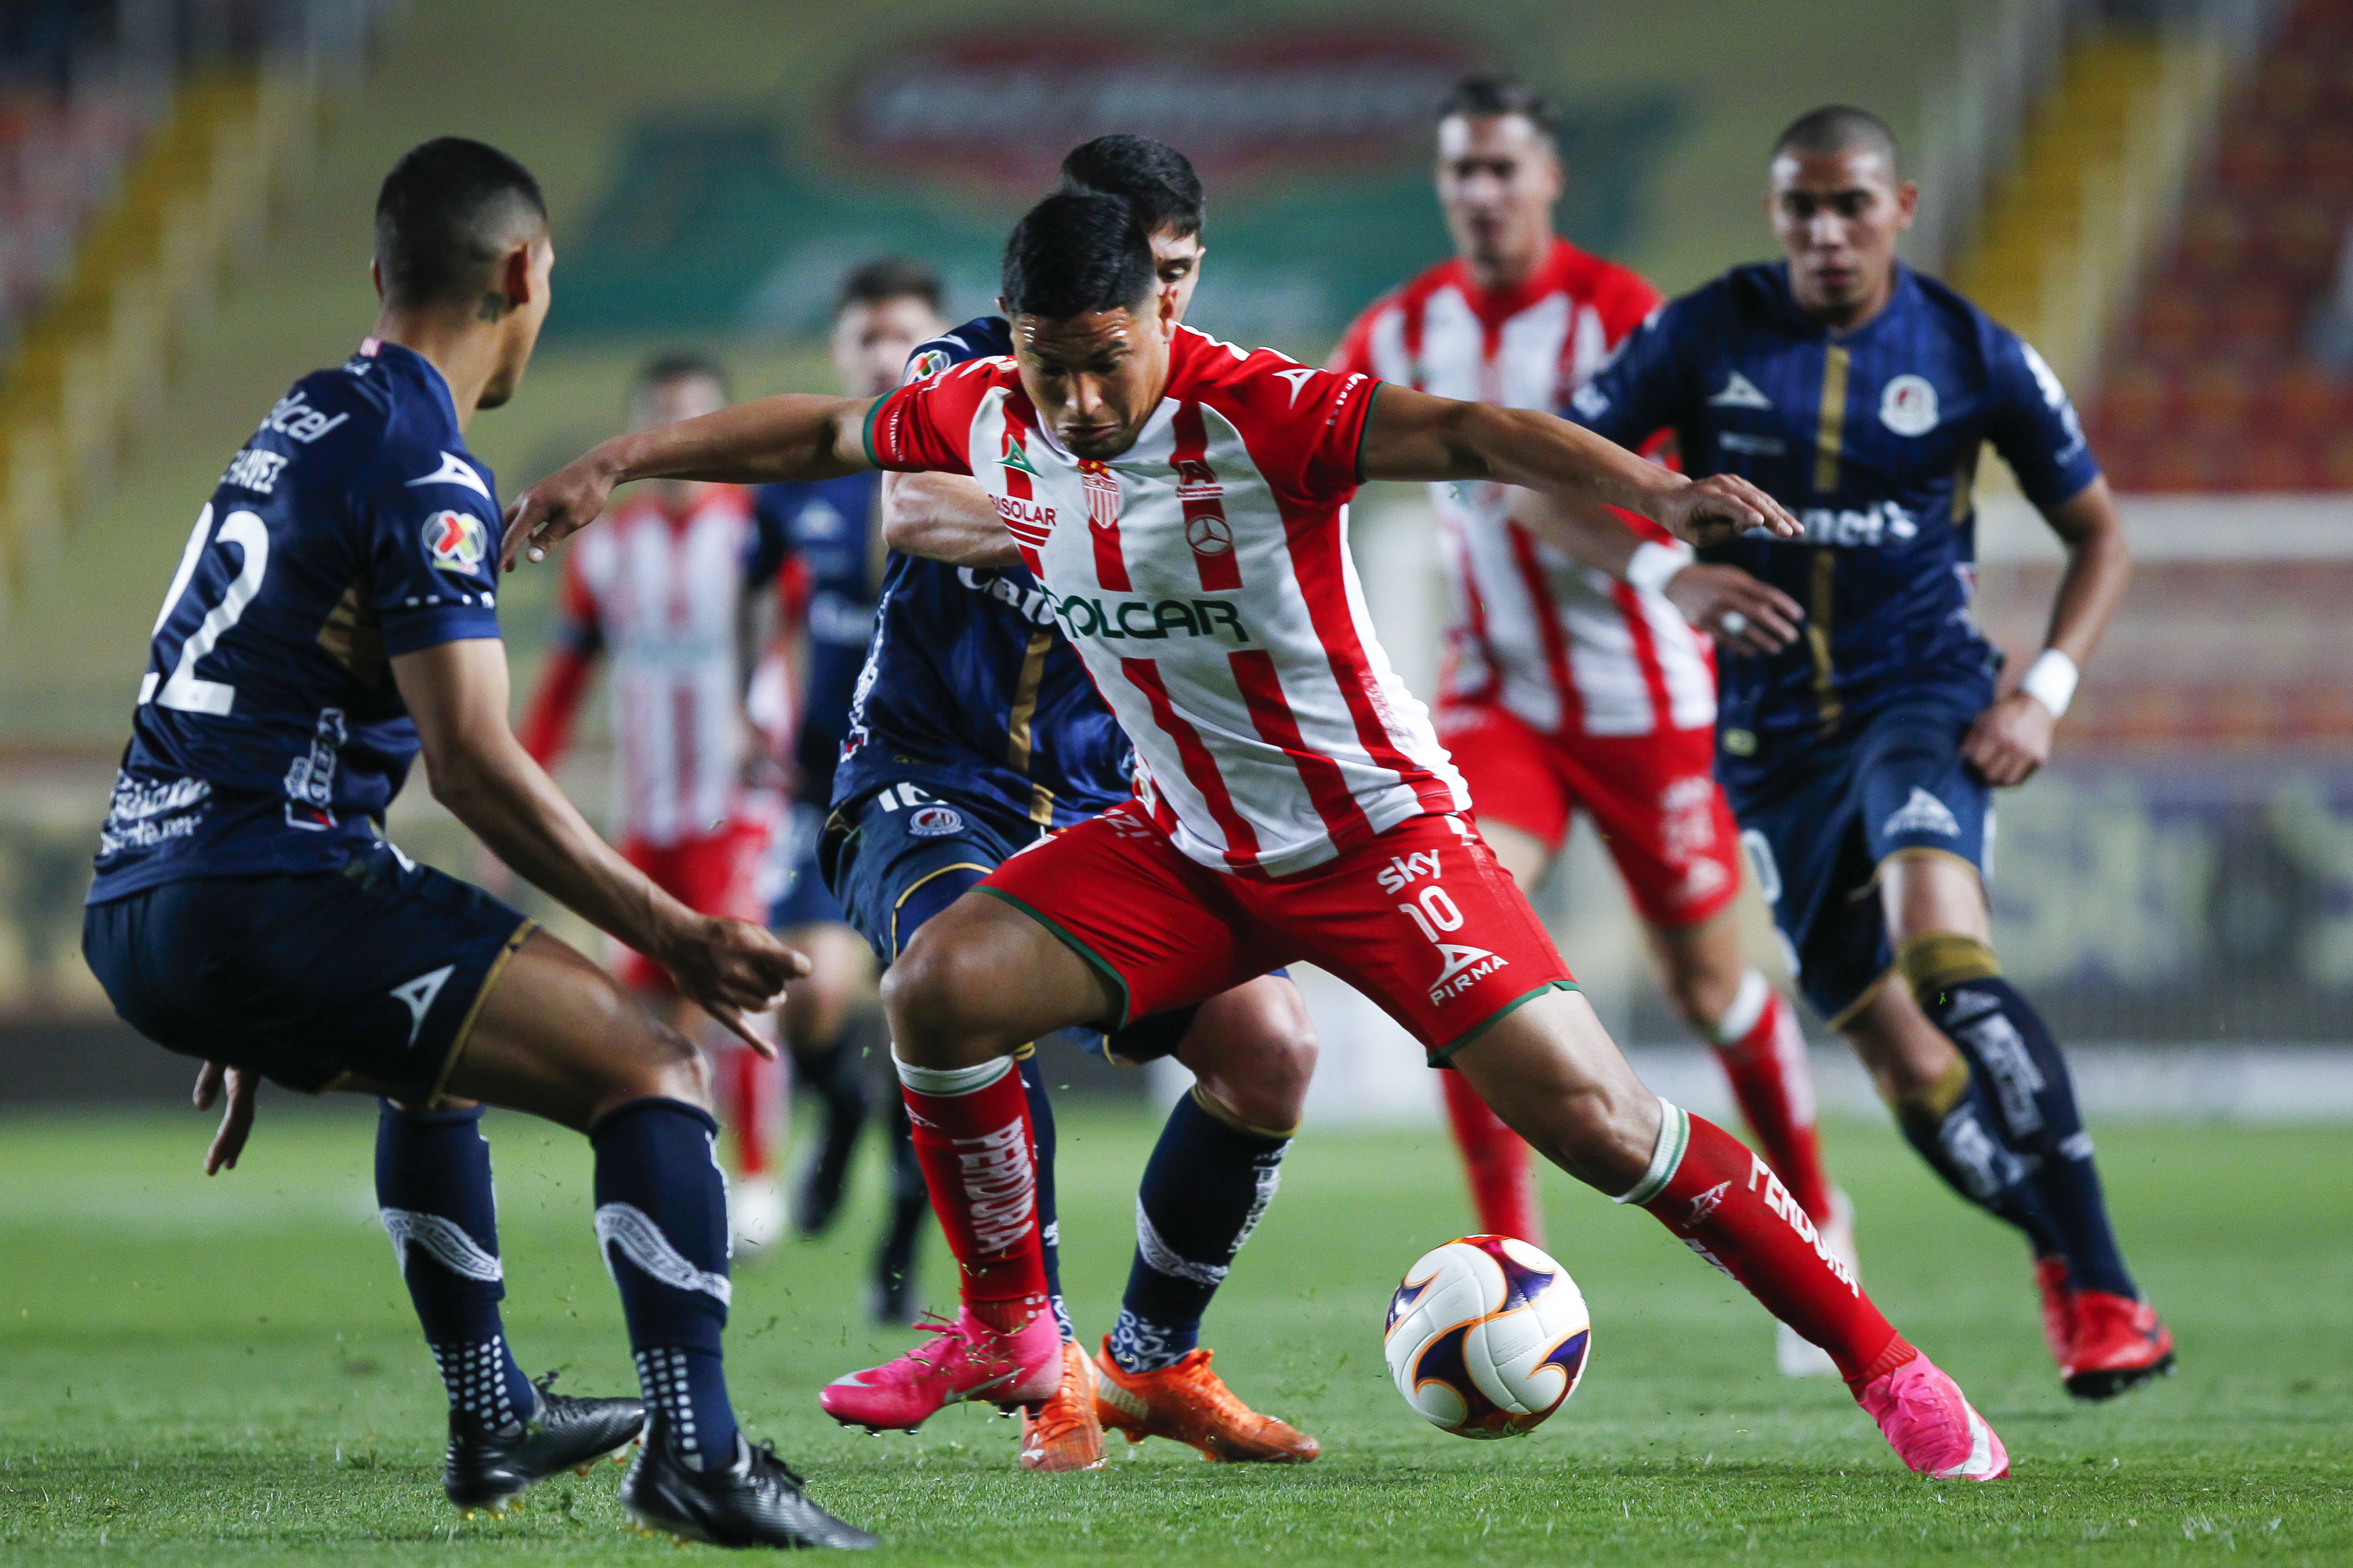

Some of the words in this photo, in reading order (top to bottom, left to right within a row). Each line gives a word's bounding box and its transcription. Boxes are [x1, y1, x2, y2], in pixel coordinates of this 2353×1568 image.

[1398, 885, 1464, 943] 10
[1429, 955, 1509, 1006] PIRMA
[952, 1115, 1036, 1254] PERDURA
